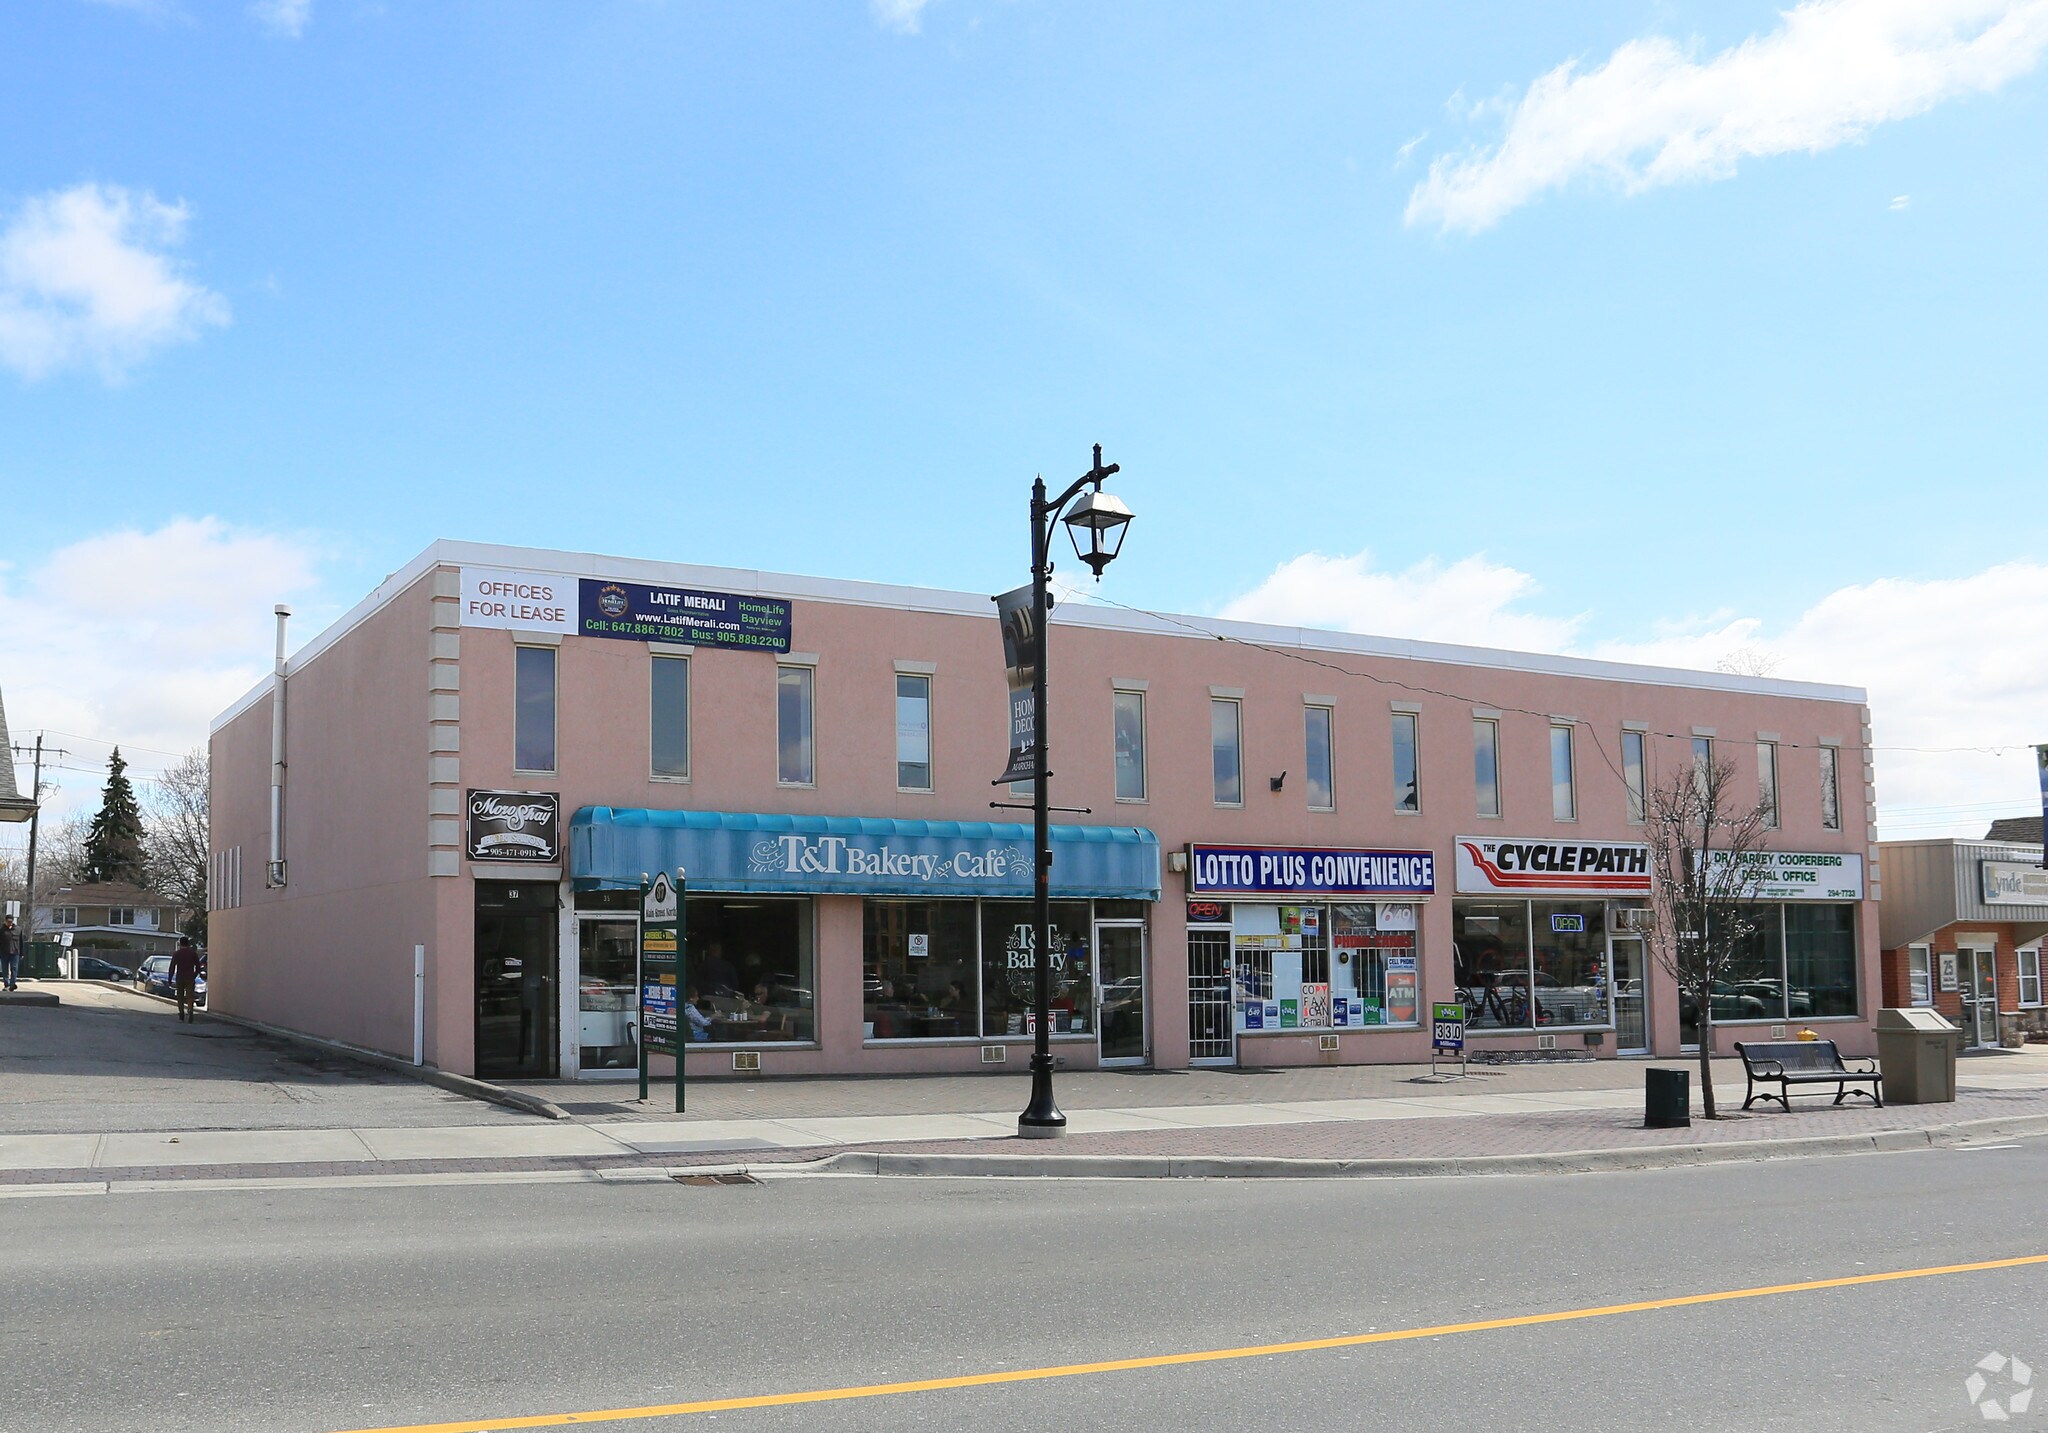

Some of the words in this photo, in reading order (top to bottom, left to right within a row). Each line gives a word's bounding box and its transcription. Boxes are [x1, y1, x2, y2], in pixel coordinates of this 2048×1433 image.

[478, 581, 553, 601] OFFICES
[650, 592, 681, 606] LATIF
[684, 595, 726, 611] MERALI
[738, 601, 785, 615] HomeLife
[469, 601, 506, 617] FOR
[511, 604, 565, 622] LEASE
[635, 613, 740, 631] www.LatifMerali.com
[741, 613, 782, 626] Bayview
[585, 618, 609, 631] Cell:
[611, 621, 684, 637] 647.886.7802
[692, 629, 714, 640] Bus:
[717, 631, 786, 648] 905.889.2200
[1014, 697, 1034, 718] HOM
[1483, 844, 1496, 853] THE
[779, 836, 846, 873] T&T
[845, 846, 939, 881] Bakery
[953, 849, 1006, 878] Café
[1778, 853, 1842, 867] COOPERBERG
[1195, 854, 1254, 886] LOTTO
[1260, 855, 1306, 886] PLUS
[1311, 855, 1433, 886] CONVENIENCE
[1782, 870, 1816, 882] OFFICE
[1189, 903, 1222, 915] OPEN
[1555, 916, 1580, 930] OPEN
[1006, 948, 1068, 972] Bakry
[1302, 985, 1328, 995] COPY
[1388, 987, 1415, 999] ATM
[1029, 1022, 1054, 1033] ON
